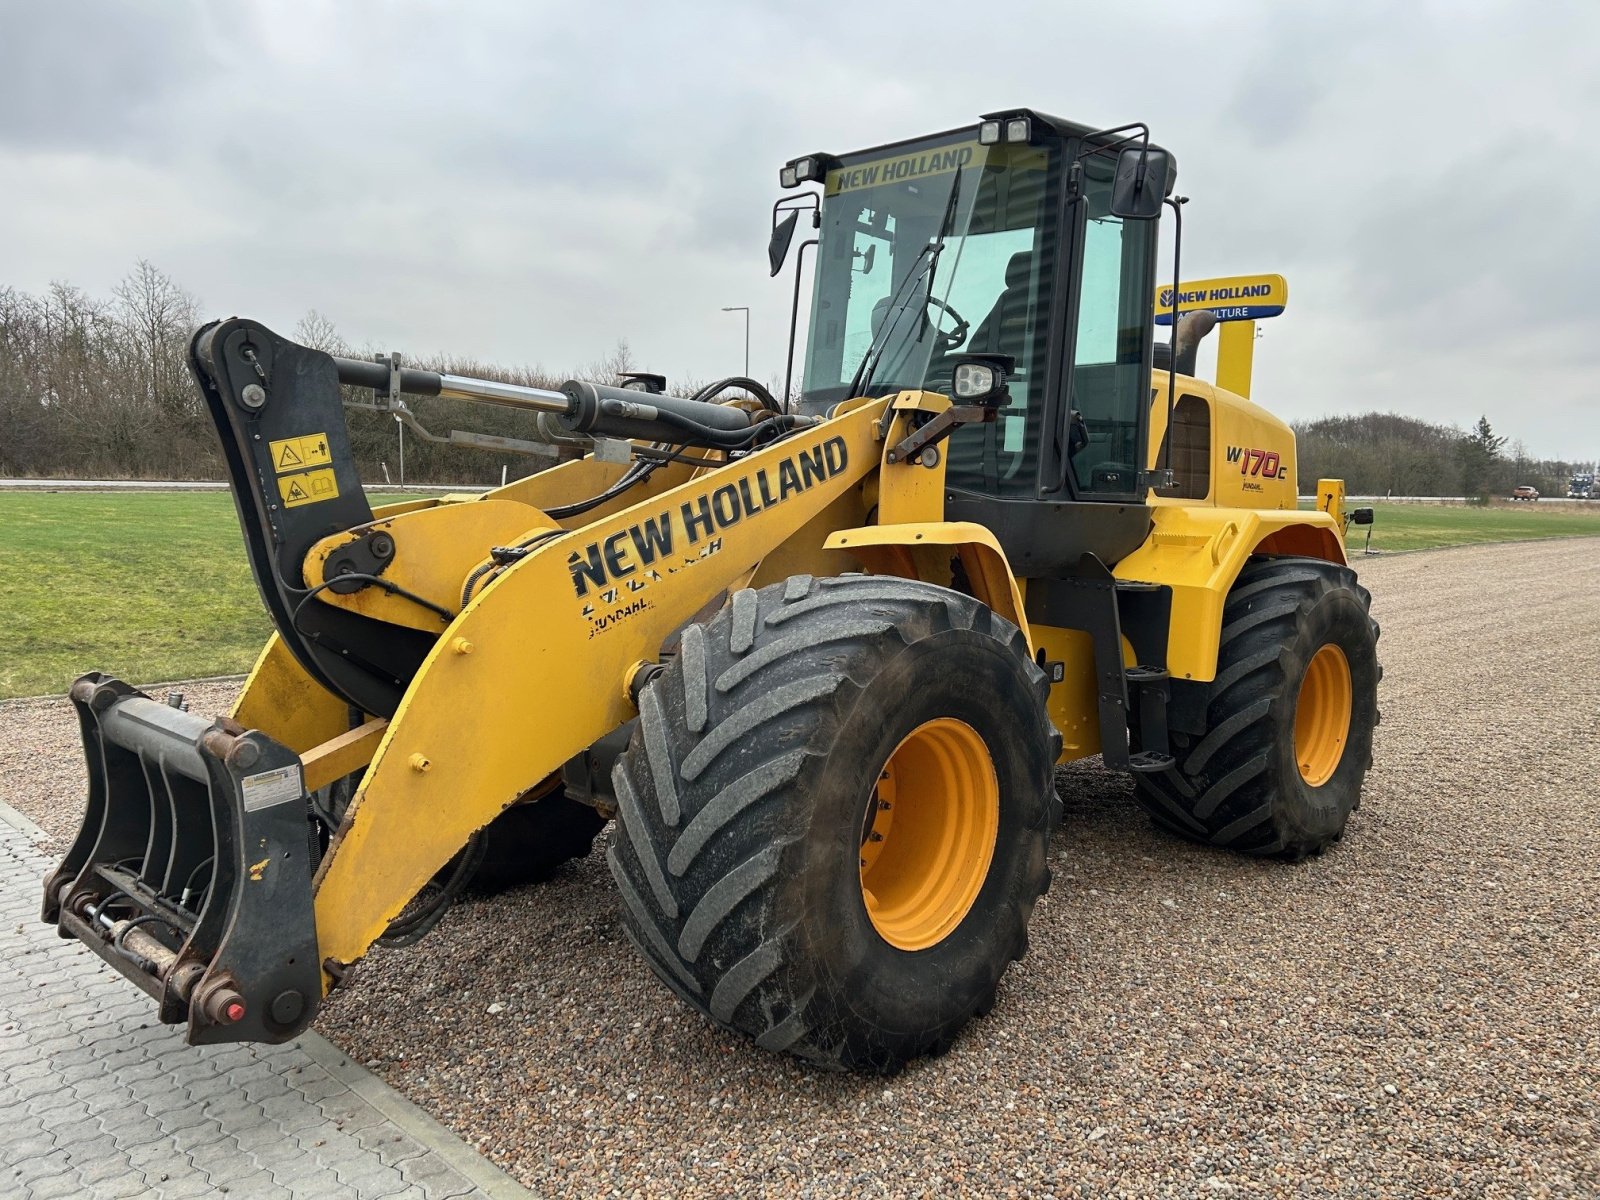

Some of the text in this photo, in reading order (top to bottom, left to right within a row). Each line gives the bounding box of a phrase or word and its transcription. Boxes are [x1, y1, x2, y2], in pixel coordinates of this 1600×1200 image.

[837, 146, 973, 191] NEW HOLLAND
[1178, 284, 1272, 304] NEW HOLLAND
[568, 511, 673, 598] NEW
[680, 435, 849, 544] HOLLAND
